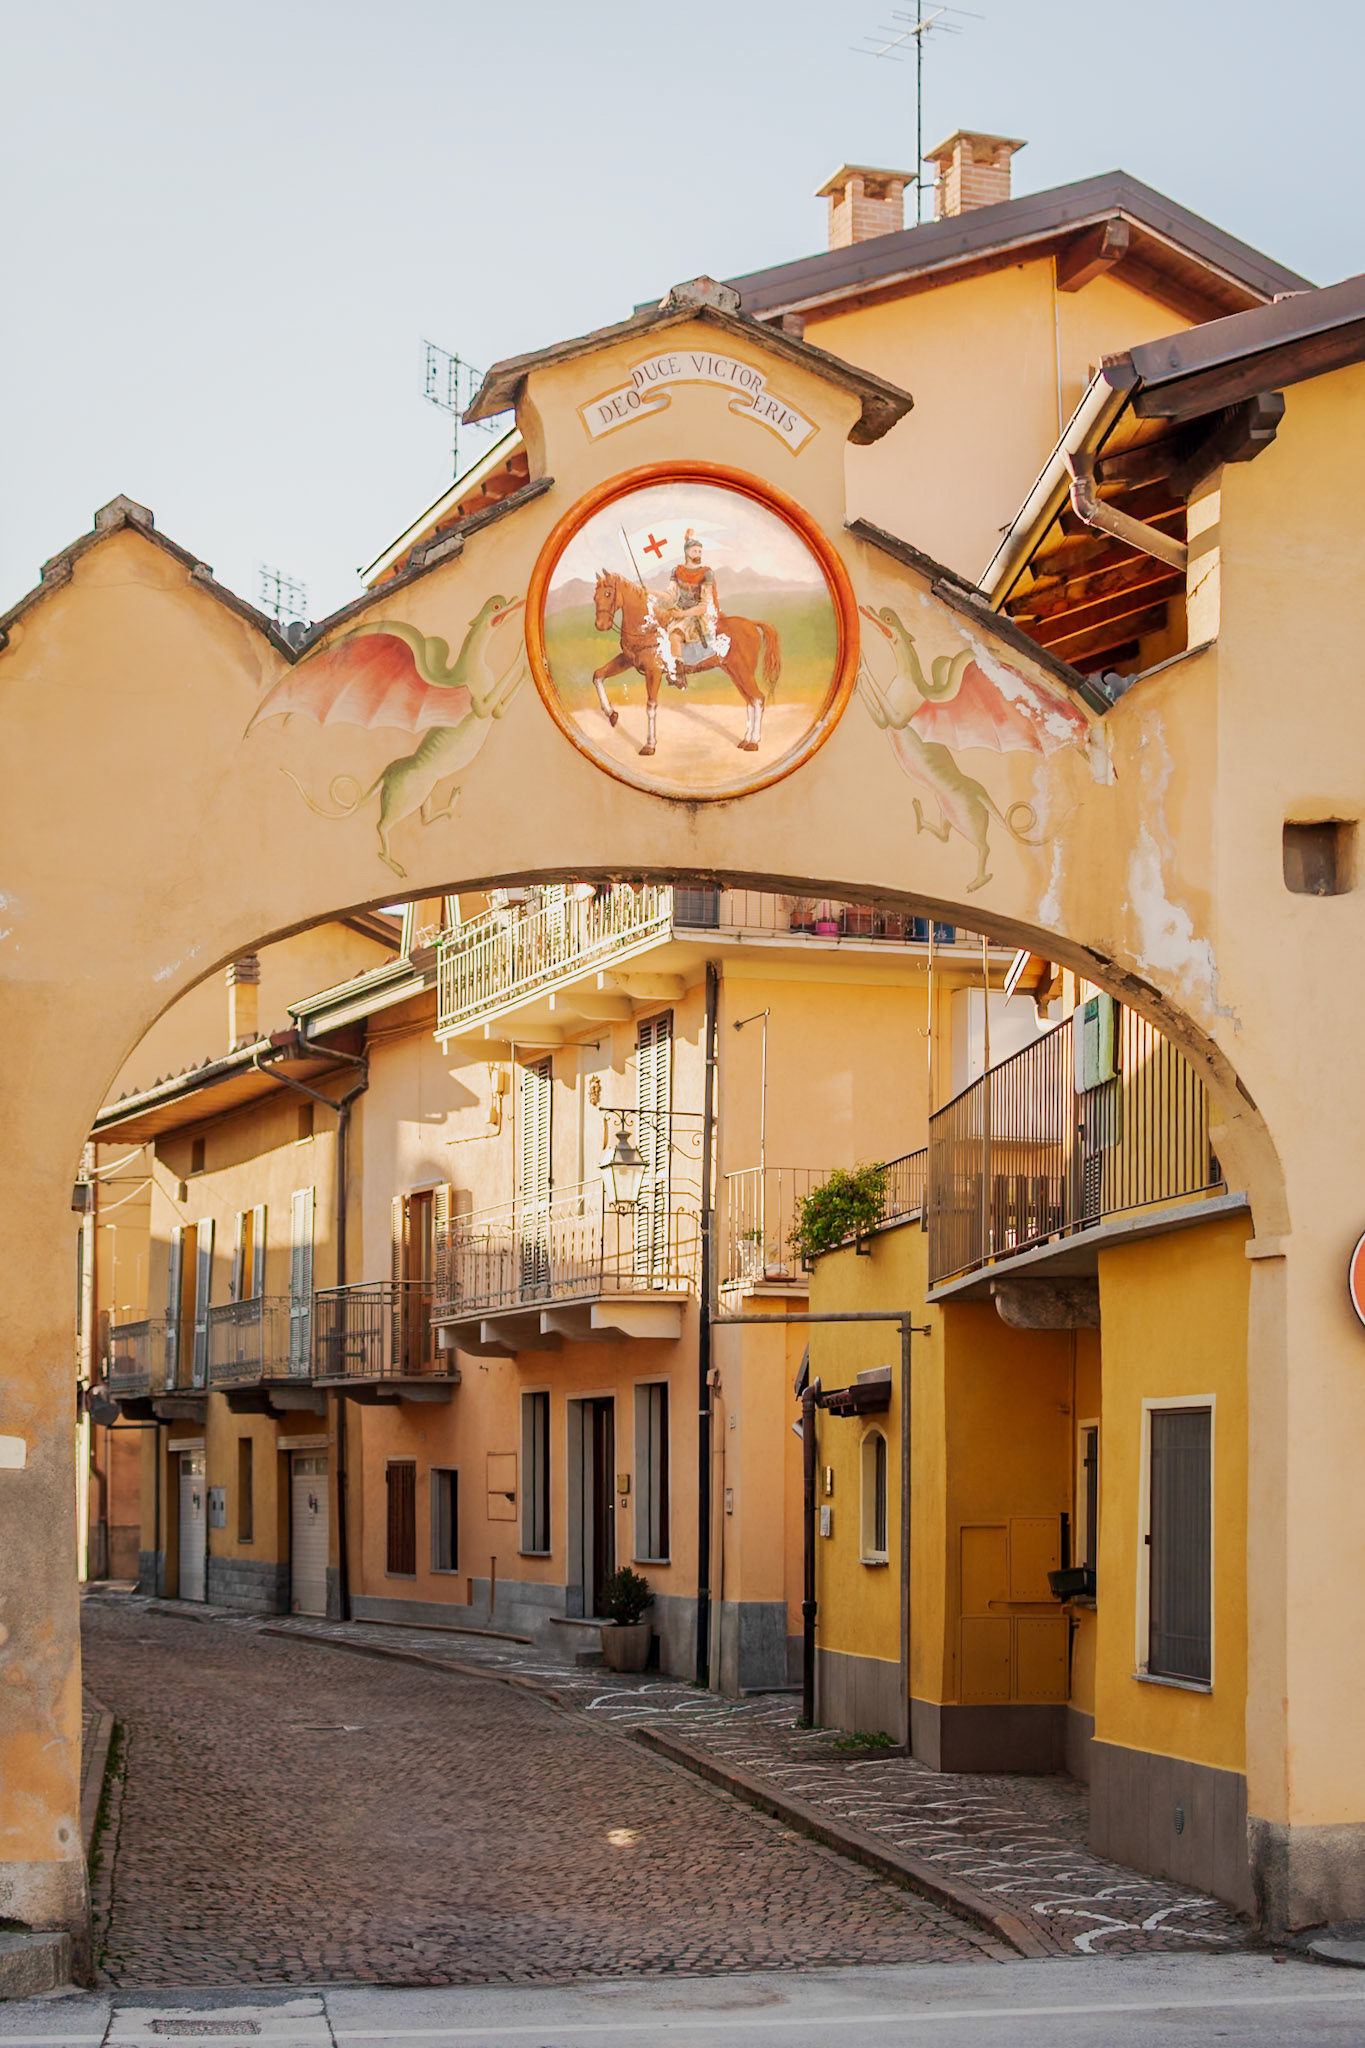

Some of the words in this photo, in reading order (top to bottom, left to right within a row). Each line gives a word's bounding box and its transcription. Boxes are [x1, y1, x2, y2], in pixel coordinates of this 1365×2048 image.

[598, 390, 641, 423] DEO
[631, 357, 681, 389] DUCE
[690, 355, 762, 393] VICTOR
[752, 396, 797, 432] ERIS
